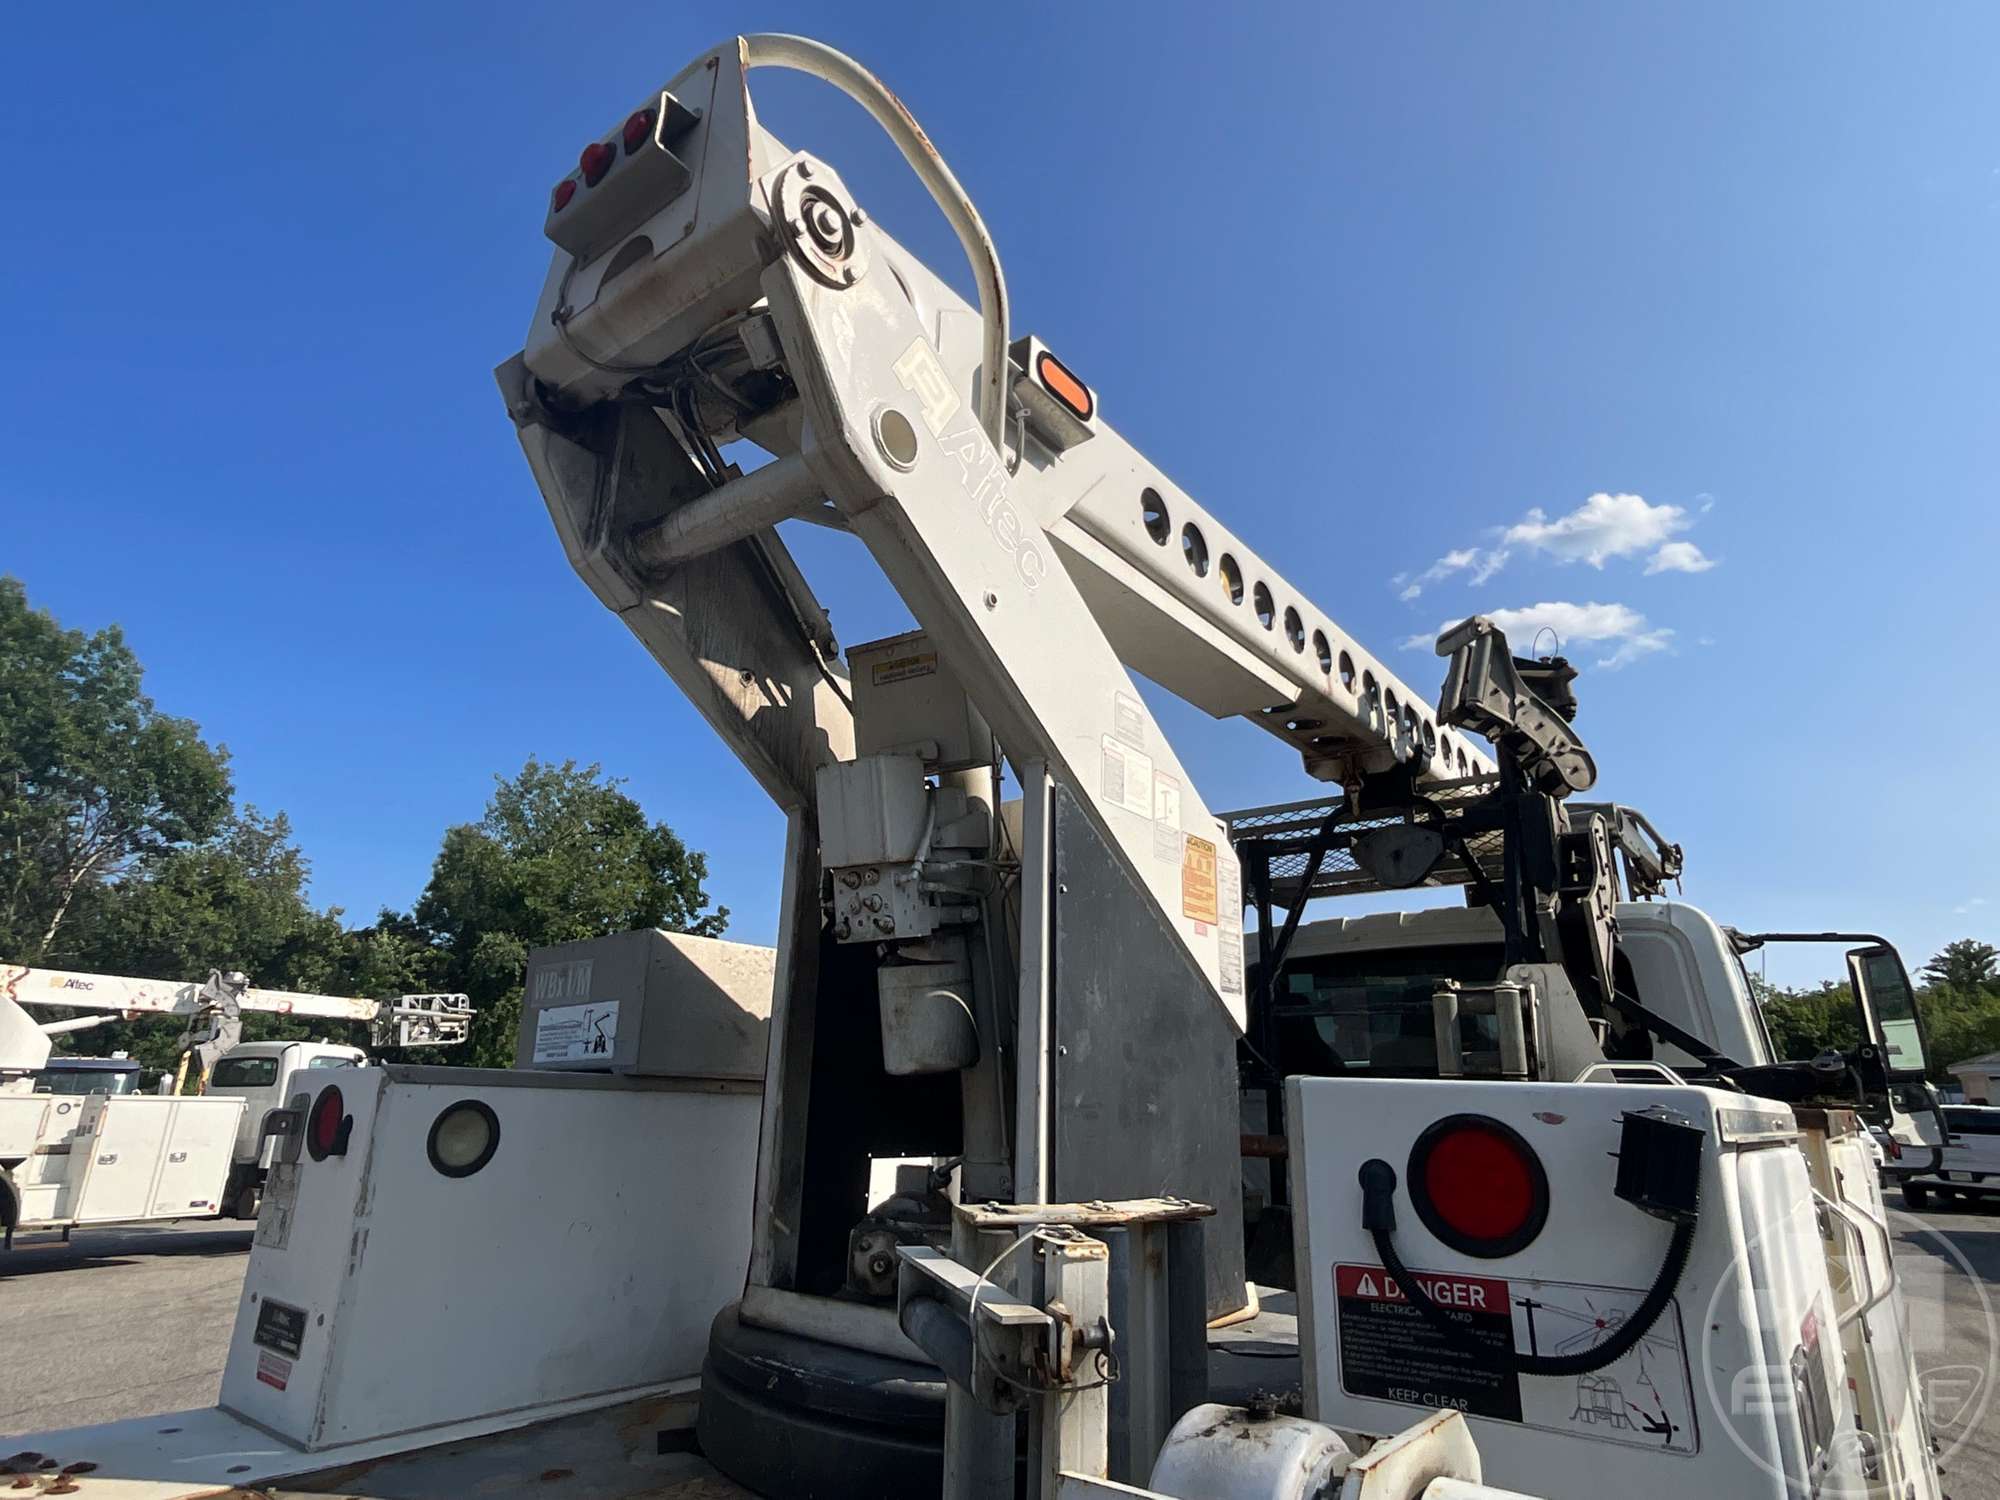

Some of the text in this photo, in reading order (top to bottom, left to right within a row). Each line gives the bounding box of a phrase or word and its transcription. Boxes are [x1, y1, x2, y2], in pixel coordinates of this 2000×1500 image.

[937, 427, 1046, 590] Altec
[64, 979, 94, 991] Altec
[1384, 1276, 1487, 1309] DNGER
[1371, 1302, 1423, 1317] ELECTRICA
[1388, 1386, 1469, 1412] KEEP CLEAR
